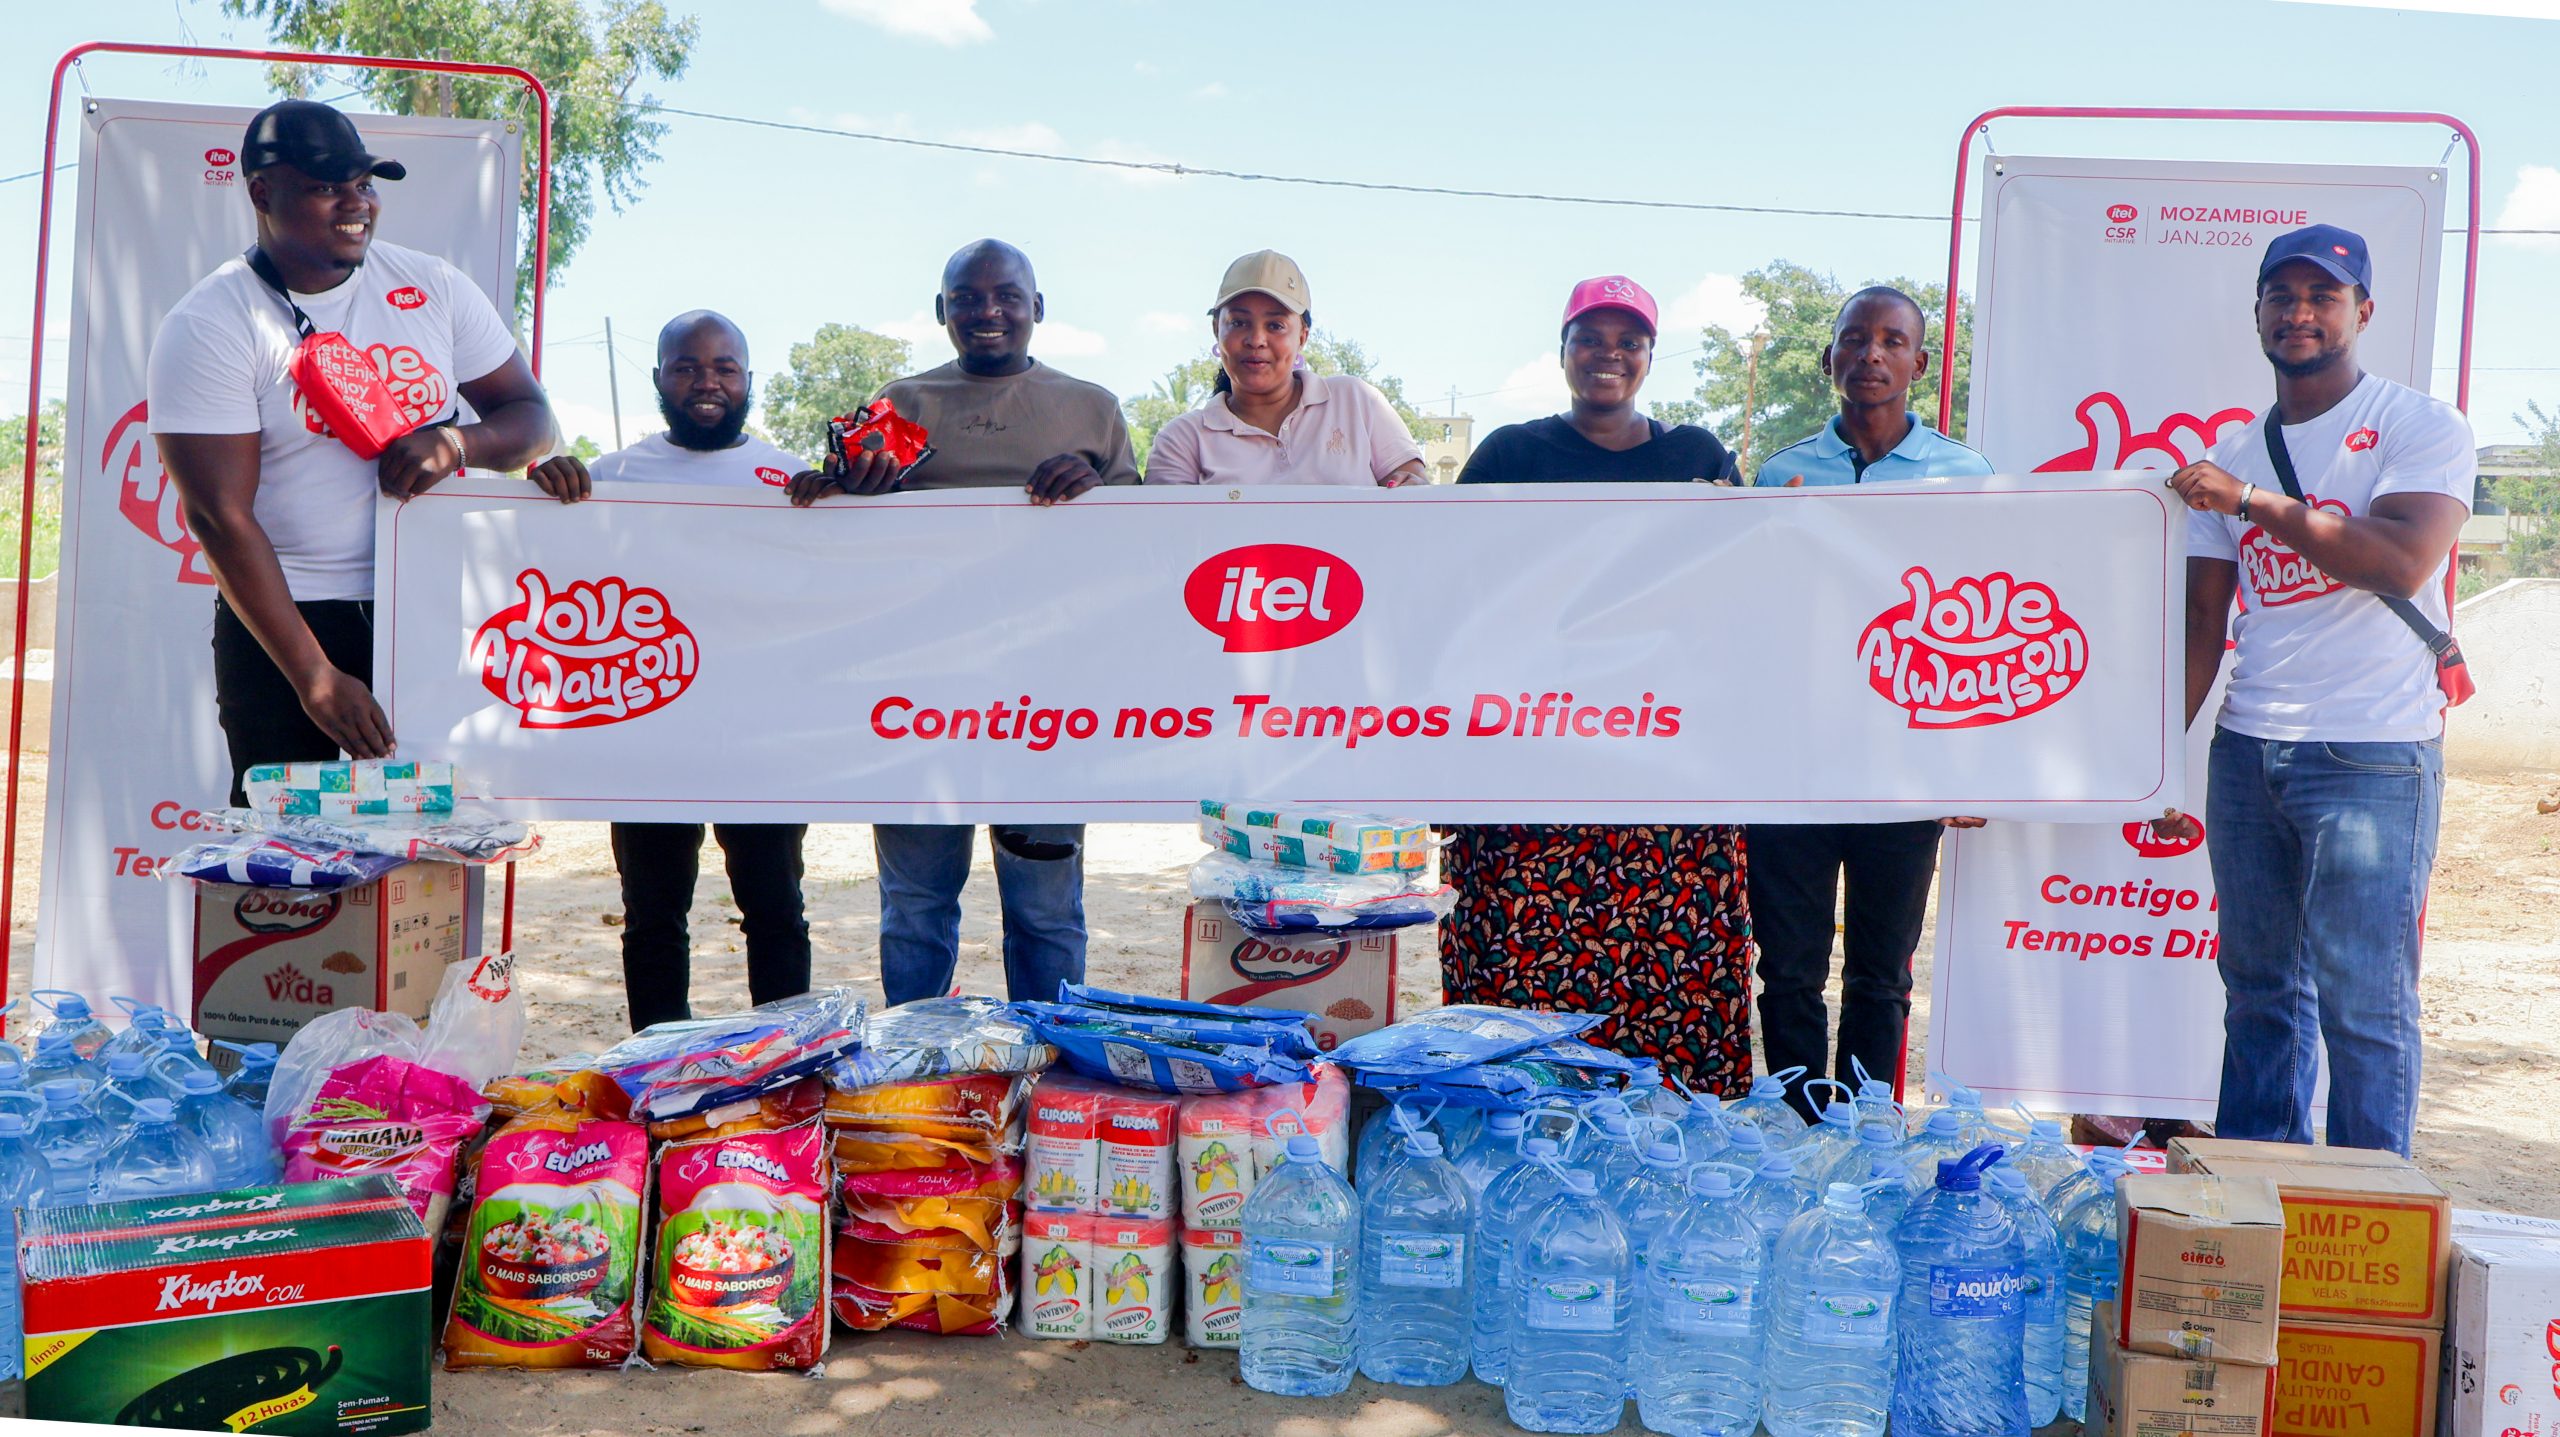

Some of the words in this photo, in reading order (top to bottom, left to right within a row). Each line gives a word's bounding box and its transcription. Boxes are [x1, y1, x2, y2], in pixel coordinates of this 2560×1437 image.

[210, 151, 231, 163] itel
[204, 169, 235, 181] CSR
[2111, 207, 2134, 219] itel
[2160, 206, 2308, 225] MOZAMBIQUE
[2105, 227, 2137, 239] CSR
[2158, 229, 2253, 247] JAN.2026
[394, 290, 422, 305] itel
[342, 394, 376, 413] etter
[761, 468, 785, 485] itel
[1216, 566, 1332, 622] itel
[506, 573, 666, 659] Love
[1893, 571, 2053, 656] Love
[870, 695, 1099, 752] Contigo
[1114, 706, 1214, 739] nos
[1233, 695, 1451, 749] Tempos
[1467, 692, 1682, 739] Dificeis
[240, 891, 332, 919] Dona
[2040, 874, 2199, 917] Contigo
[2004, 920, 2153, 961] Tempos
[1238, 938, 1340, 966] Dona
[264, 963, 334, 1005] Vida
[203, 1011, 226, 1021] 100%
[228, 1011, 247, 1024] Óleo
[248, 1015, 269, 1026] Puro
[270, 1016, 280, 1026] de
[282, 1018, 300, 1029] Soja
[960, 1088, 983, 1102] 5kg
[1038, 1107, 1086, 1125] EUROPA
[1111, 1114, 1161, 1131] EUROPA
[715, 1149, 791, 1183] EUROPA
[918, 1175, 953, 1188] Arroz
[146, 1193, 287, 1219] Kingtox
[1199, 1197, 1237, 1217] MARIANA
[152, 1228, 299, 1255] Kingtox
[2295, 1240, 2369, 1258] QUALITY
[487, 1264, 496, 1275] O
[496, 1267, 525, 1284] MAIS
[527, 1268, 598, 1285] SABOROSO
[2282, 1257, 2400, 1286] ANDLES
[155, 1270, 266, 1311] Kingtox
[265, 1284, 305, 1303] COIL
[677, 1273, 686, 1285] O
[685, 1277, 713, 1291] MAIS
[714, 1274, 783, 1292] SABOROSO
[1955, 1281, 2001, 1301] AQUA
[2312, 1286, 2348, 1300] VELAS
[1035, 1303, 1073, 1320] MARIANA
[1106, 1311, 1145, 1329] MARIANA
[1035, 1322, 1077, 1333] SUPER
[1206, 1331, 1241, 1342] UPER
[2193, 1323, 2215, 1333] Olam
[30, 1339, 66, 1366] limão
[2299, 1343, 2334, 1355] VELAS
[774, 1351, 796, 1367] 5kg
[2278, 1357, 2385, 1388] CANDL
[2182, 1398, 2203, 1406] Olam
[2278, 1383, 2352, 1402] QUALITY
[238, 1411, 258, 1426] 12
[260, 1394, 307, 1418] Horas
[2274, 1403, 2371, 1430] LIMP
